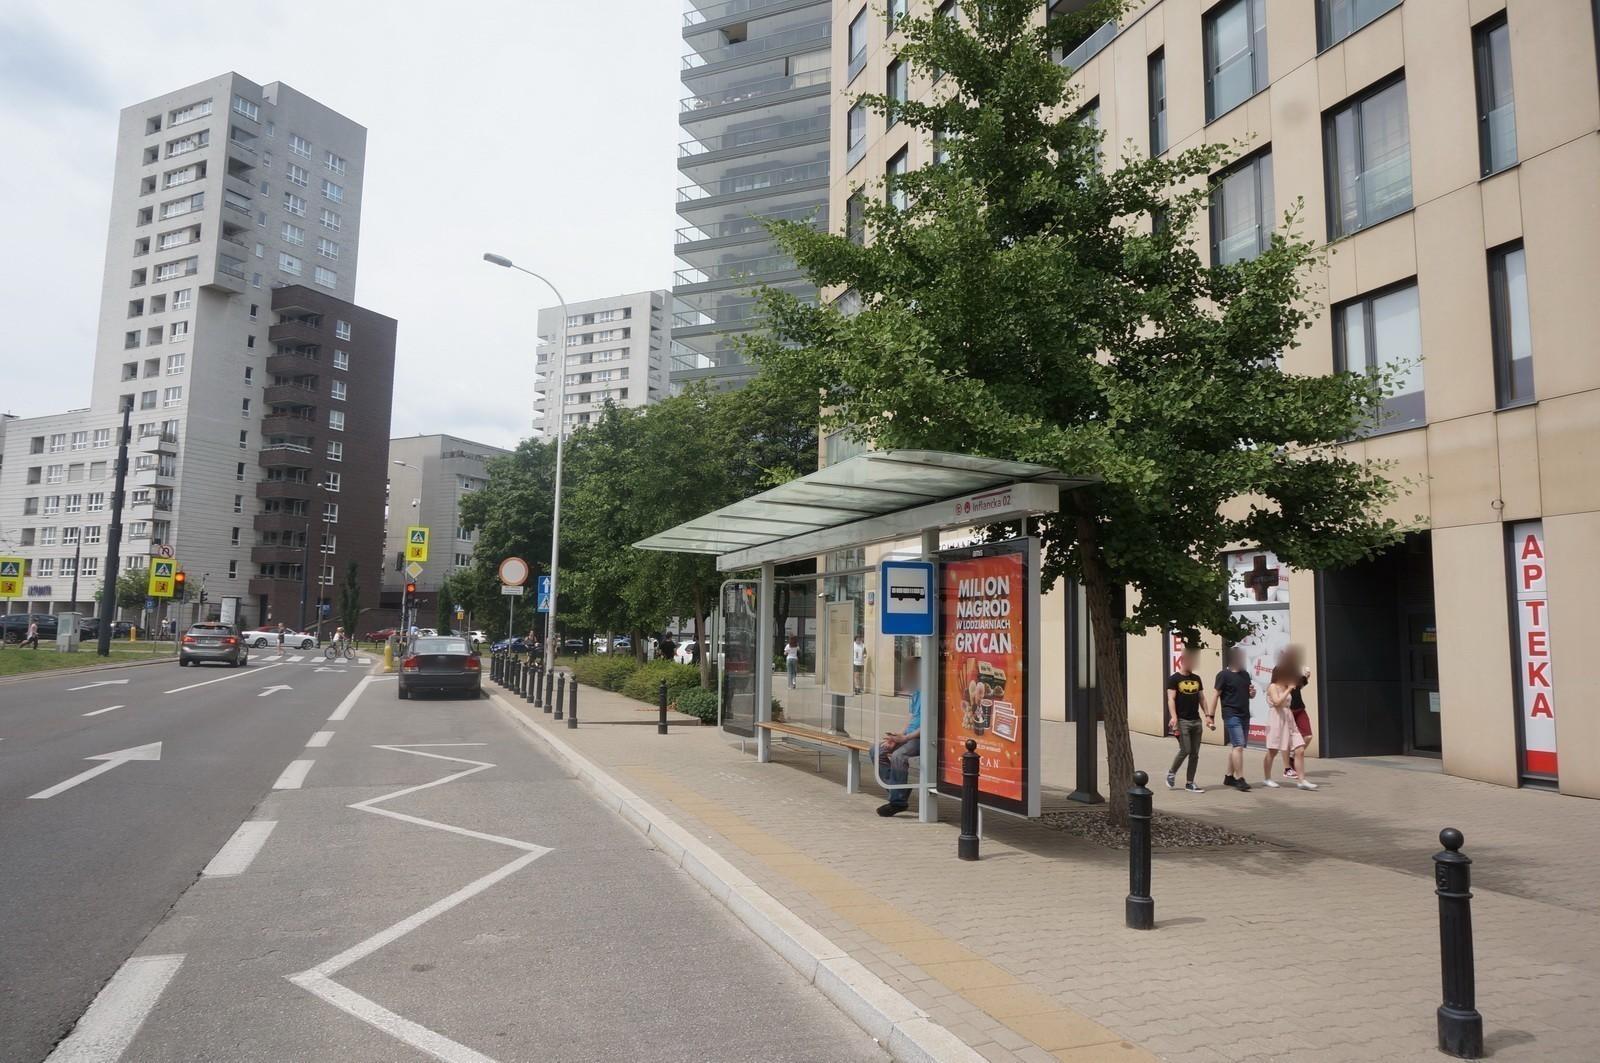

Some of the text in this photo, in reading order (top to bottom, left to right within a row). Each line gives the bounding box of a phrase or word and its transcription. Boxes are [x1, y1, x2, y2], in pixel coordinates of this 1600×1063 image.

[1002, 495, 1011, 507] 02
[958, 576, 1010, 598] MILION
[956, 594, 1011, 618] NAGRÓD
[1520, 534, 1554, 719] APTEKA
[955, 632, 1012, 654] GRYCAN
